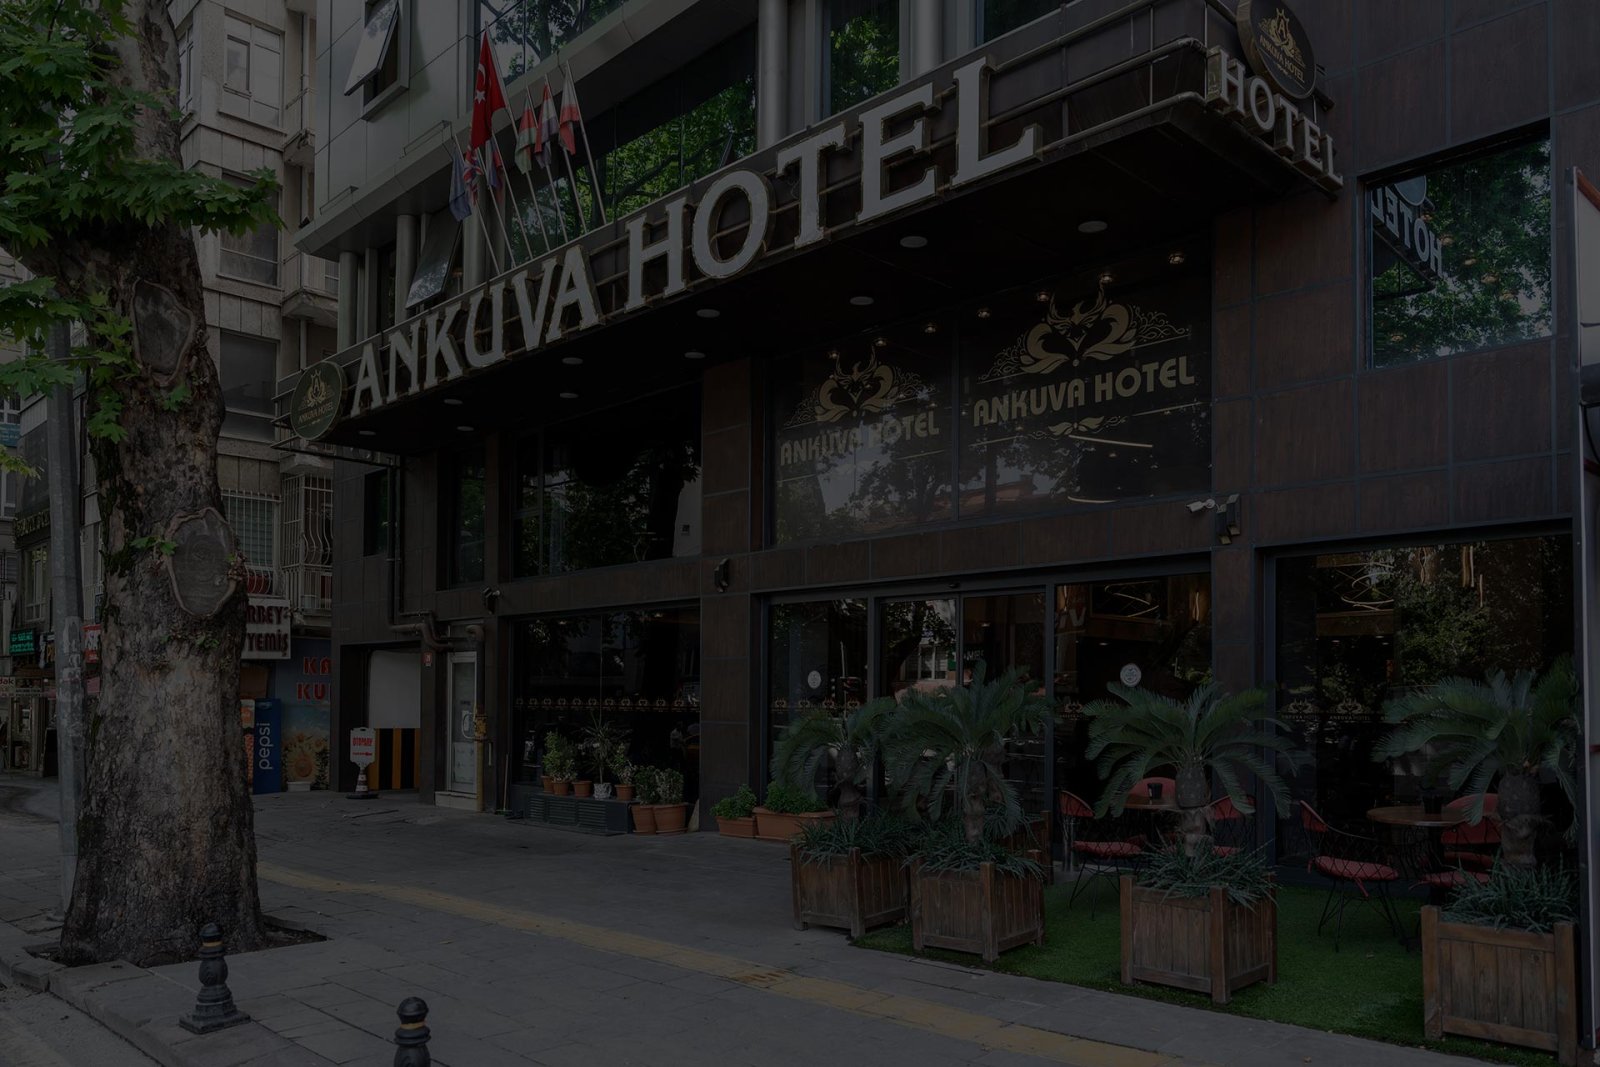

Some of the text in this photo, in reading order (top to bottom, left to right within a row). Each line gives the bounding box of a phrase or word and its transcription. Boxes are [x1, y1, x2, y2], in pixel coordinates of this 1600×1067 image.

[1285, 57, 1305, 83] HOTEL
[1221, 50, 1343, 188] HOTEL
[351, 56, 1036, 418] ANKUVA HOTEL
[973, 355, 1195, 427] ANKUVA HOTEL
[780, 410, 940, 467] ANKUVA HOTEL
[296, 682, 331, 701] KU
[256, 722, 274, 770] pepsi
